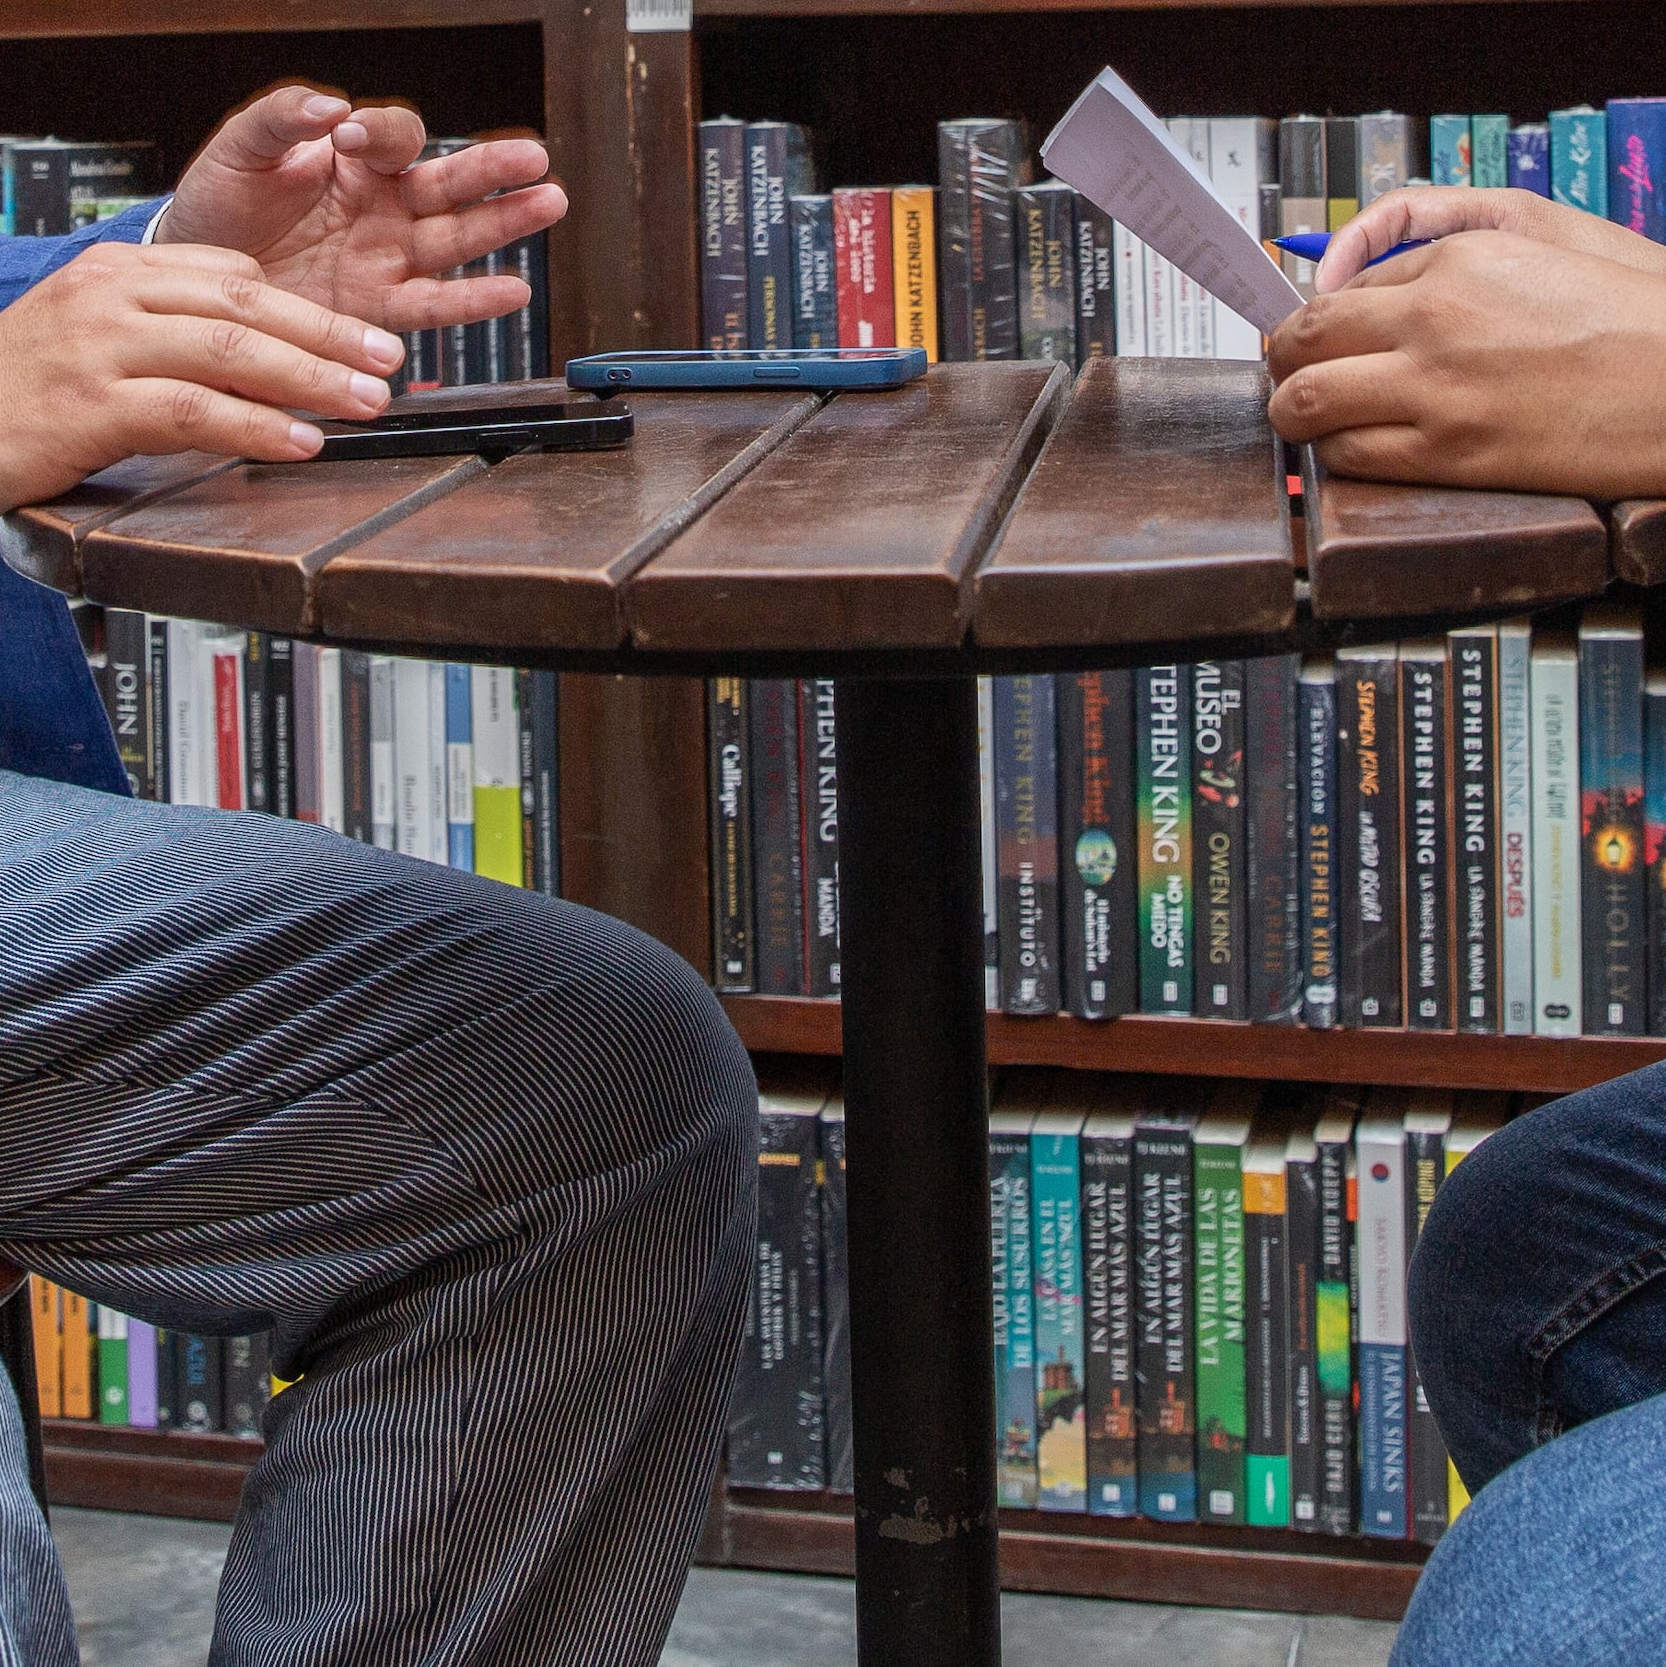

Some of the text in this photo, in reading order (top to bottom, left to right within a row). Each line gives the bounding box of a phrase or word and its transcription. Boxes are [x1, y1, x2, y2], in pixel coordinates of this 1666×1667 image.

[705, 147, 724, 257] KATZENBACH
[723, 177, 739, 226] JOHN
[752, 145, 770, 256] KATZENBACH
[769, 176, 786, 225] JOHN
[799, 224, 817, 319] KATZENBACH
[815, 250, 829, 293] JOHN
[906, 210, 925, 350] JOHN KATZENBACH
[1029, 209, 1047, 319] KATZENBACH
[1046, 239, 1063, 288] JOHN
[1078, 221, 1096, 318] KATZENBACH
[1094, 247, 1110, 291] JOHN
[112, 662, 140, 736] JOHN
[1221, 688, 1241, 714] EL
[1355, 680, 1380, 797] STEPHEN KING
[1462, 648, 1486, 853] STEPHEN KING
[719, 744, 744, 817] Calliope
[1015, 776, 1035, 845] KING
[1414, 671, 1436, 865] STEPHEN KING
[1152, 786, 1181, 863] KING
[1309, 707, 1331, 977] ELEVACIÓN STEPHEN KING
[1506, 758, 1527, 918] KING DESPUÉS
[816, 877, 834, 937] MANDA
[1017, 862, 1039, 968] INSTITUTO
[1151, 893, 1167, 949] MIEDO
[1167, 875, 1185, 967] NO TENGAS
[1207, 832, 1231, 964] OWEN KING
[1606, 883, 1630, 1001] HOLLY
[1009, 1177, 1033, 1368] DE LOS SUSURROS
[1087, 1181, 1108, 1353] EN ALGÚN LUGAR
[1108, 1182, 1128, 1382] DEL MAR AZUL
[1141, 1173, 1161, 1344] EN LUGAR
[1164, 1174, 1184, 1373] DEL MAR AZUL
[1196, 1187, 1220, 1367] LA VIDA DE LAS
[1221, 1188, 1244, 1342] MARIONETAS
[1323, 1215, 1342, 1265] DAVID
[1326, 1449, 1344, 1492] BAJO
[1380, 1352, 1404, 1494] JAPAN SINKS
